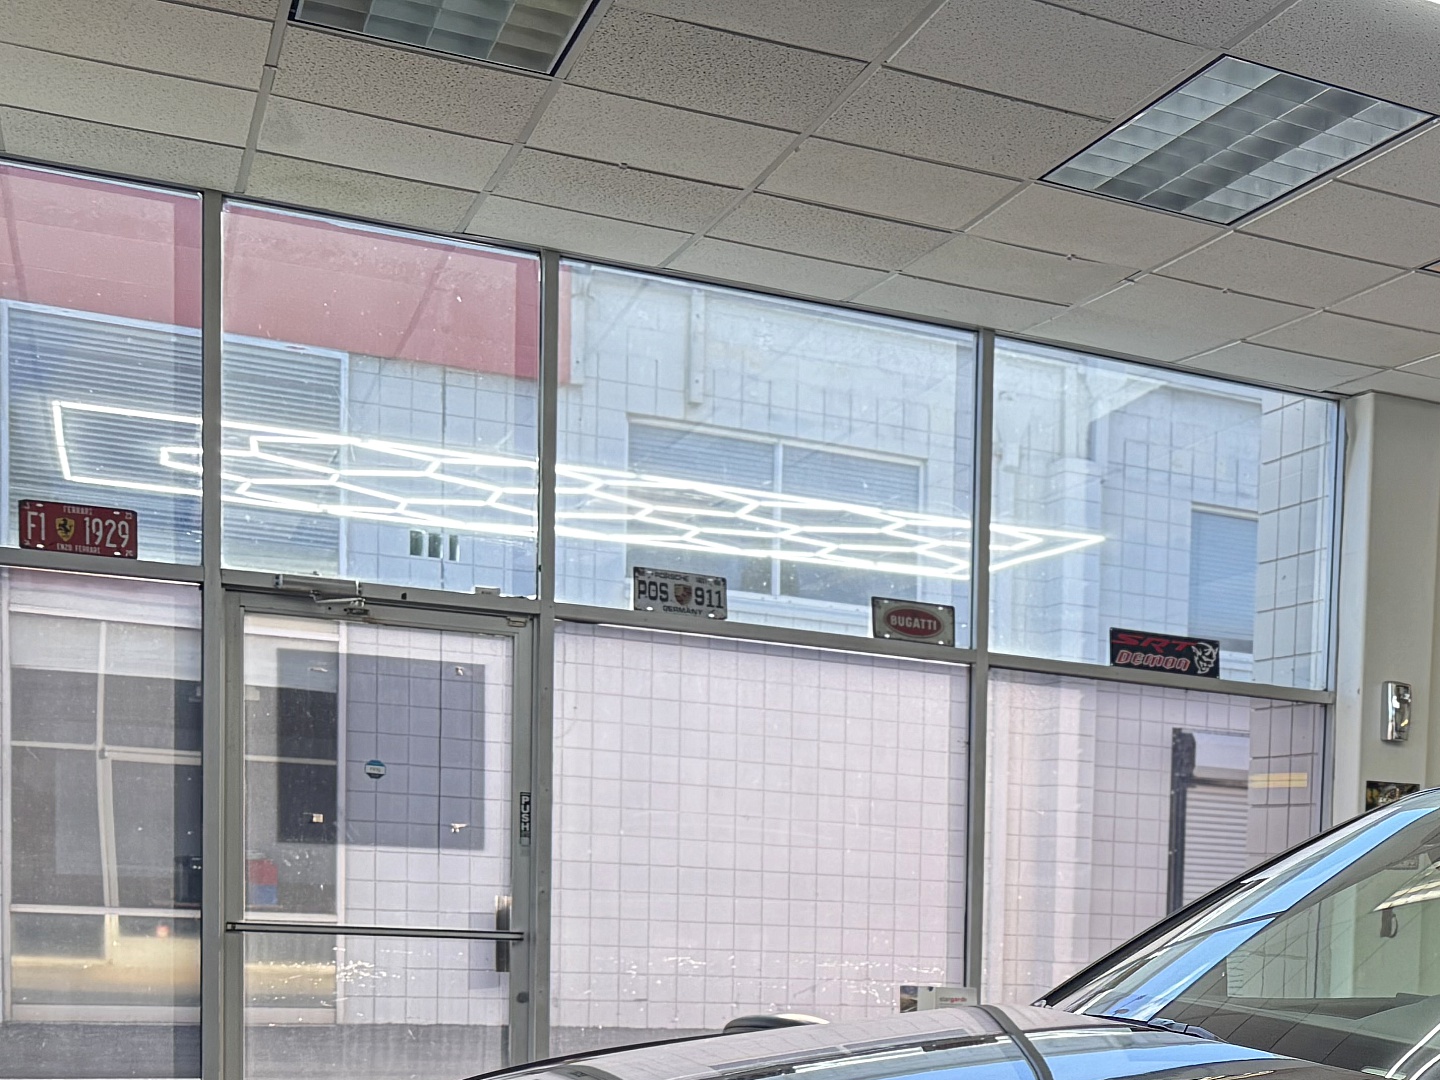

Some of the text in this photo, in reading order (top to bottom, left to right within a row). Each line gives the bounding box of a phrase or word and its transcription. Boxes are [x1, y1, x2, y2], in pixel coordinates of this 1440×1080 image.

[26, 510, 130, 549] F1 1929
[637, 580, 724, 609] POS 911
[890, 614, 938, 631] BUGATTI
[1111, 633, 1199, 654] SRT
[521, 795, 530, 831] PUSH
